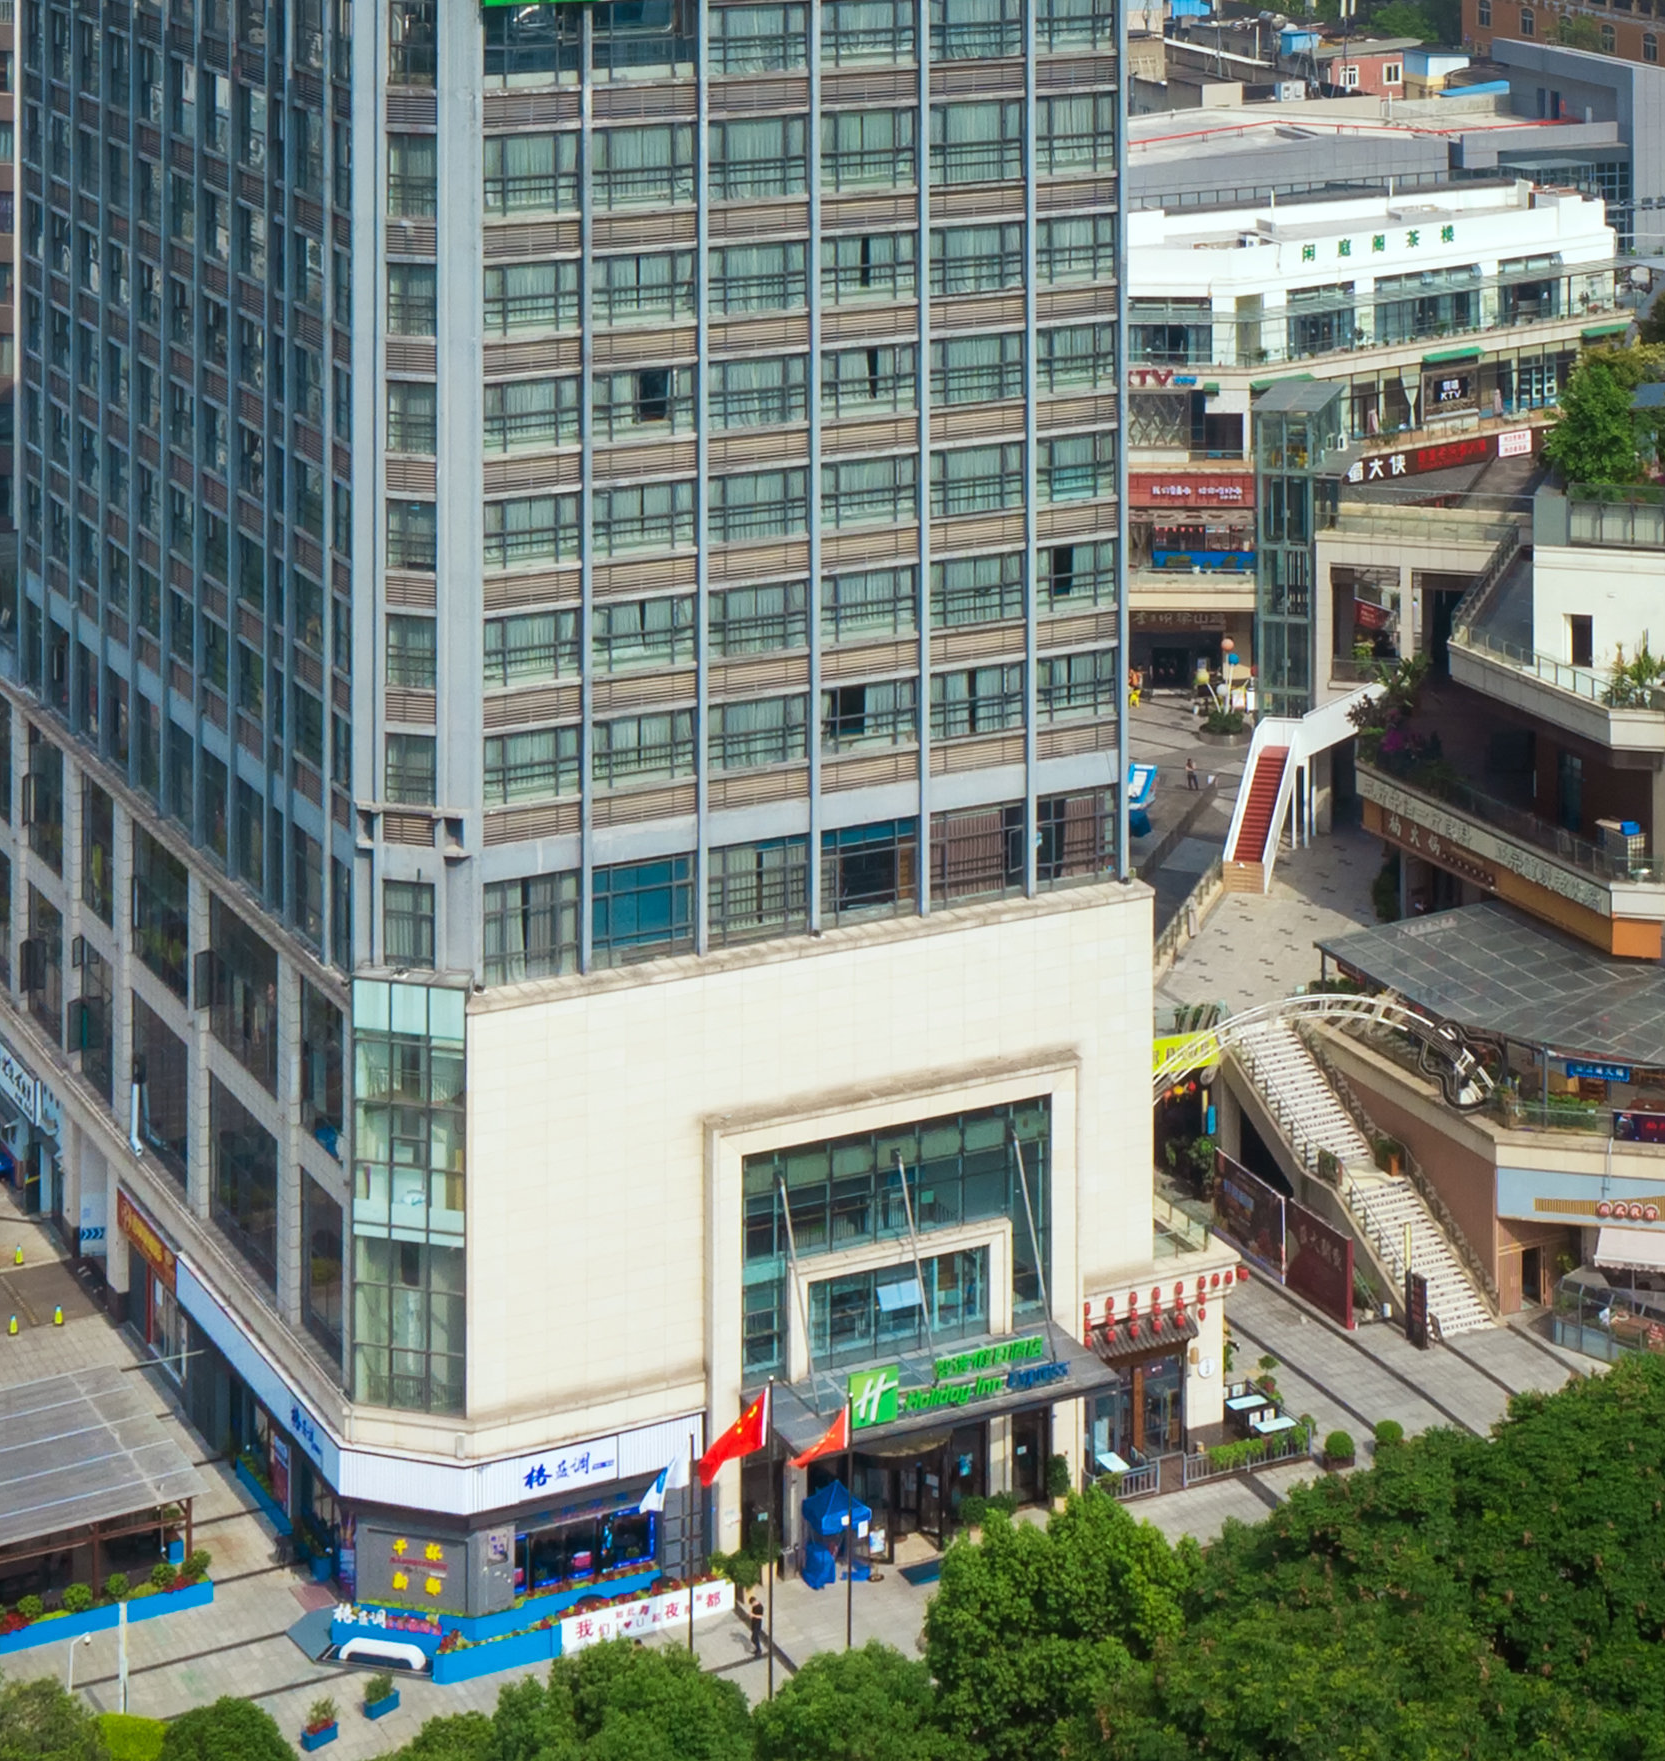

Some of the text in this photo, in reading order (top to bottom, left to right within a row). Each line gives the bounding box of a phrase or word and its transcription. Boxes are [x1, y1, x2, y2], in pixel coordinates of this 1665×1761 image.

[1302, 225, 1454, 262] 闲庭阁茶楼
[1440, 390, 1461, 401] KTV
[976, 1376, 1003, 1397] Inn
[1007, 1361, 1070, 1390] Express
